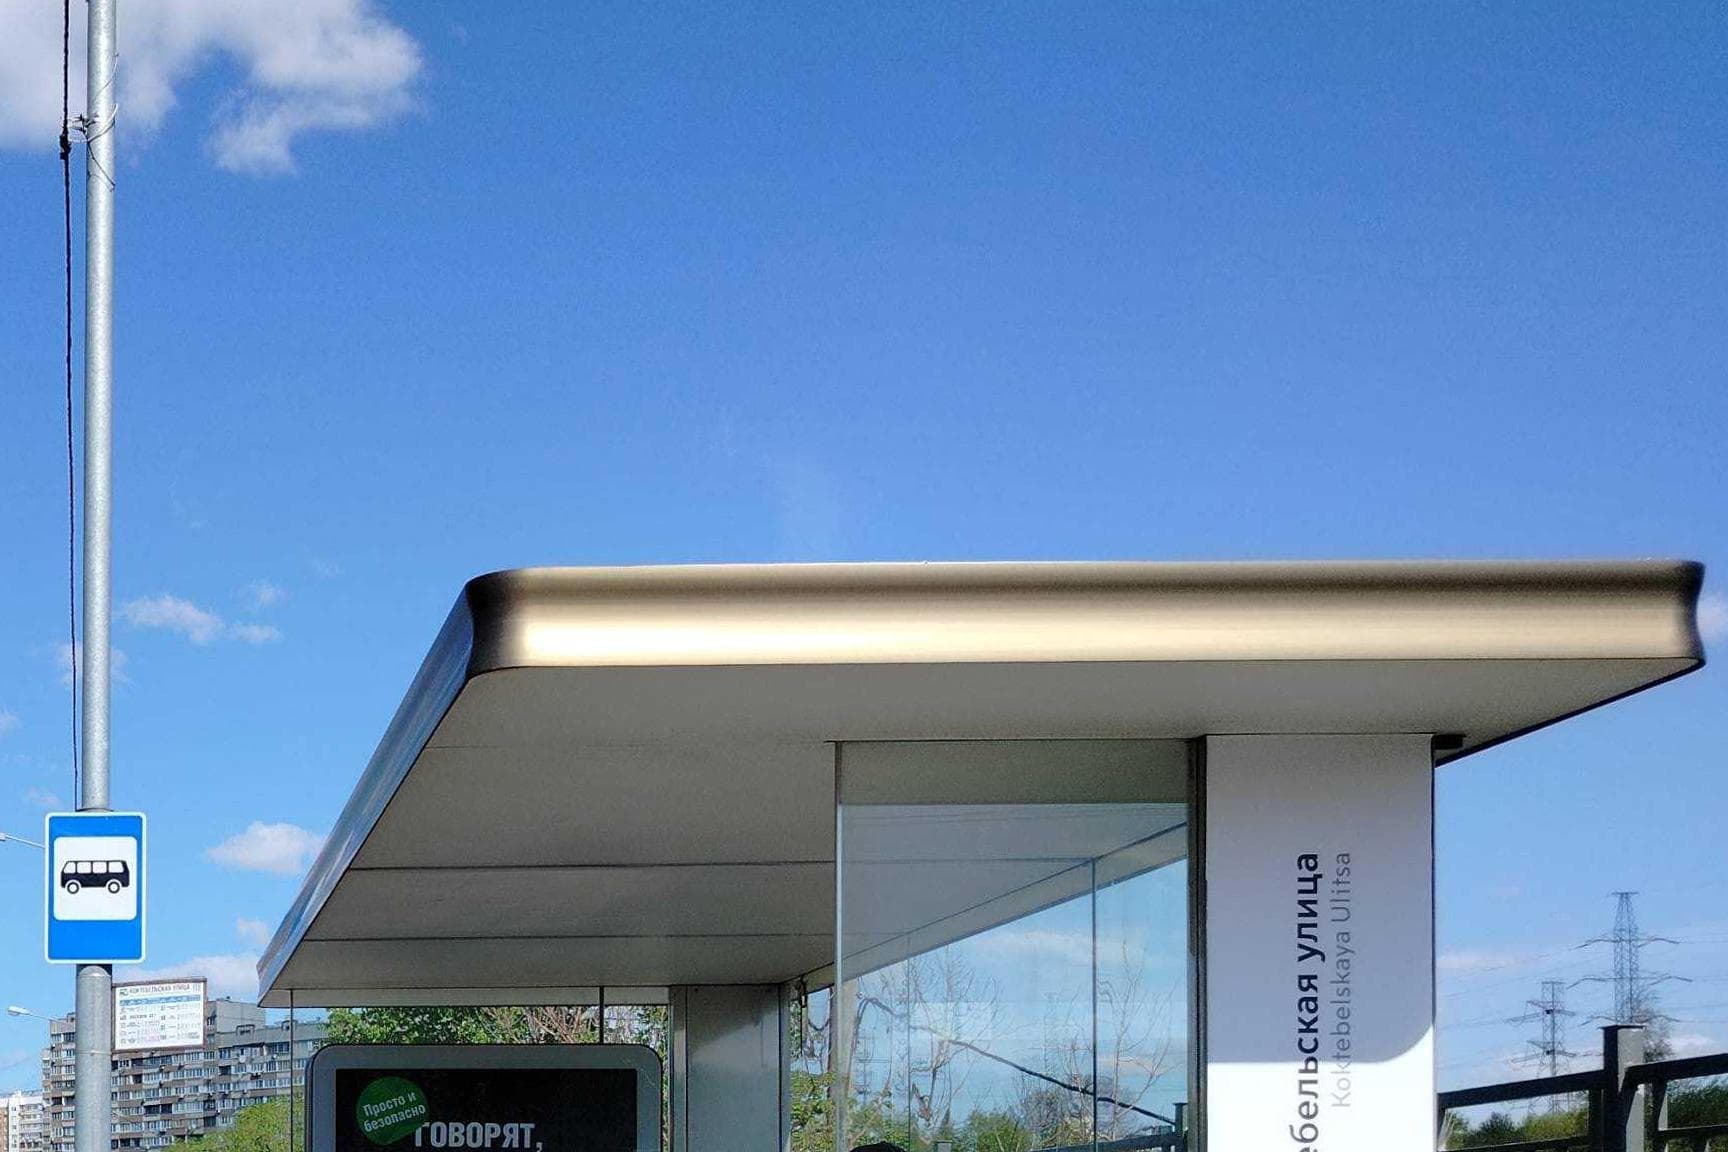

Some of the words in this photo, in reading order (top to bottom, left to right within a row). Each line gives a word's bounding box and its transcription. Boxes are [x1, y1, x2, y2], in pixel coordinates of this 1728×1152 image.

[1297, 853, 1325, 962] улица
[1330, 852, 1351, 922] Ulitsa
[1330, 931, 1356, 1107] Koktebelskaya
[363, 1095, 407, 1118] Просто
[363, 1104, 426, 1133] безопасно
[415, 1122, 543, 1152] ГОВОРЯТ,
